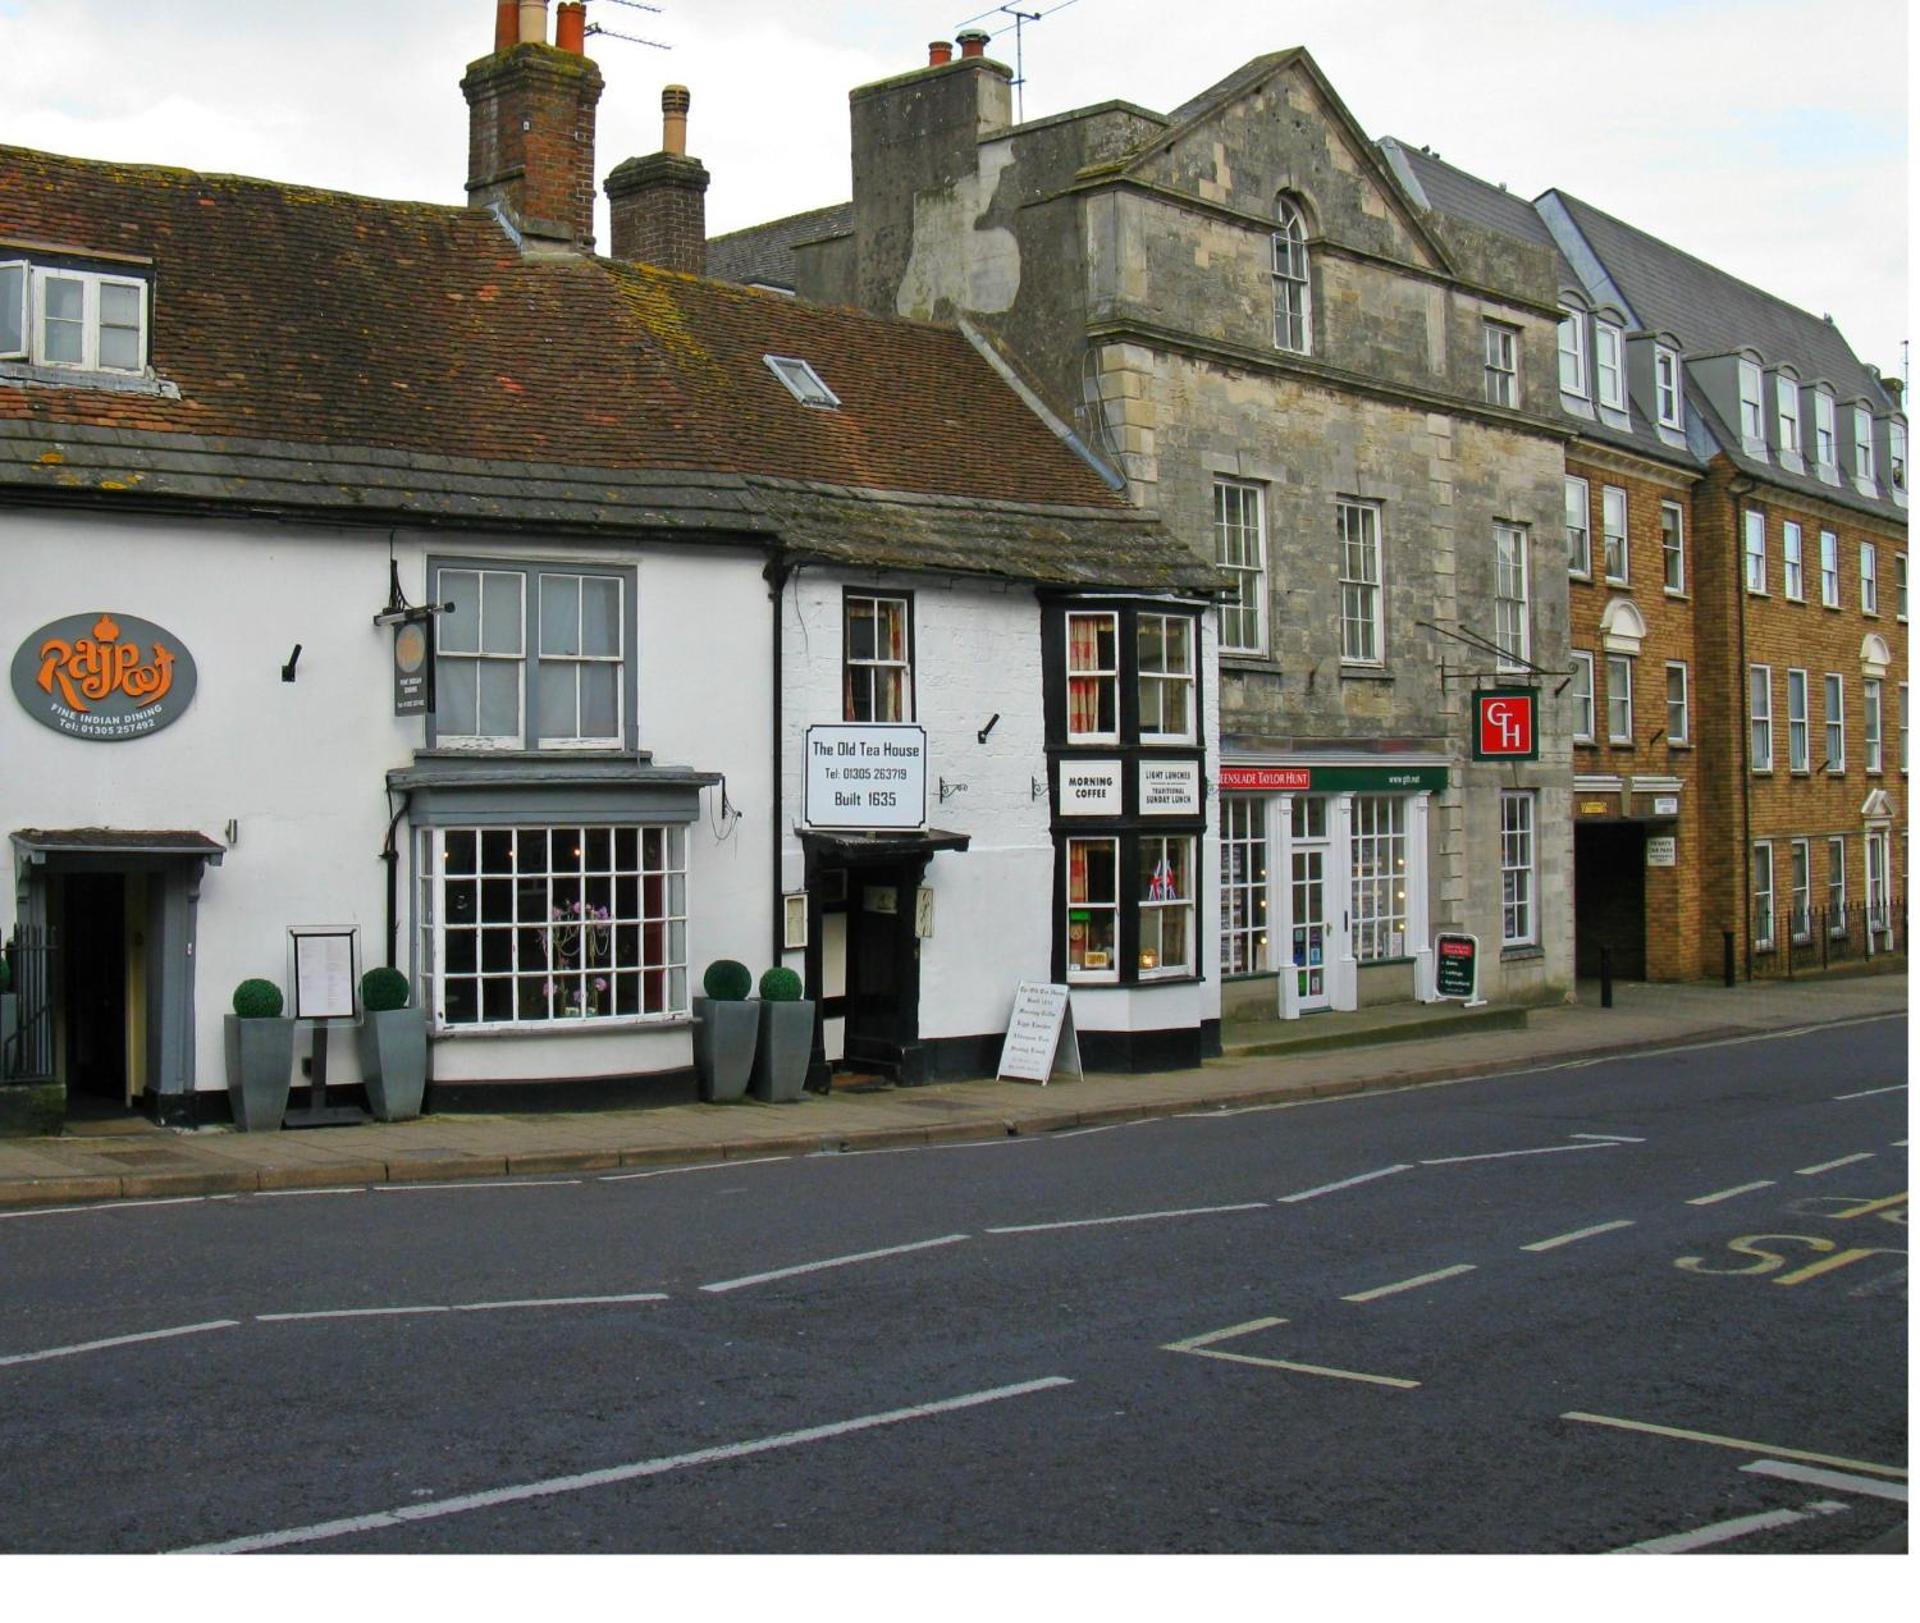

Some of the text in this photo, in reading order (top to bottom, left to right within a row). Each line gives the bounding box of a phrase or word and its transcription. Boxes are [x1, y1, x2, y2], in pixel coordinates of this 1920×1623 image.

[51, 703, 162, 725] FINE INDIAN DINING
[81, 724, 114, 735] 01305
[116, 719, 155, 734] 257492
[813, 742, 919, 757] The Old Tea House
[843, 768, 871, 780] 01305
[873, 768, 907, 780] 263719
[1146, 771, 1191, 780] LIGHT LUNCHES
[1068, 777, 1113, 786] MORNING
[835, 791, 897, 806] Built 1635
[1075, 789, 1106, 798] COFFEE
[1146, 795, 1191, 804] SUNDAY LUNCH
